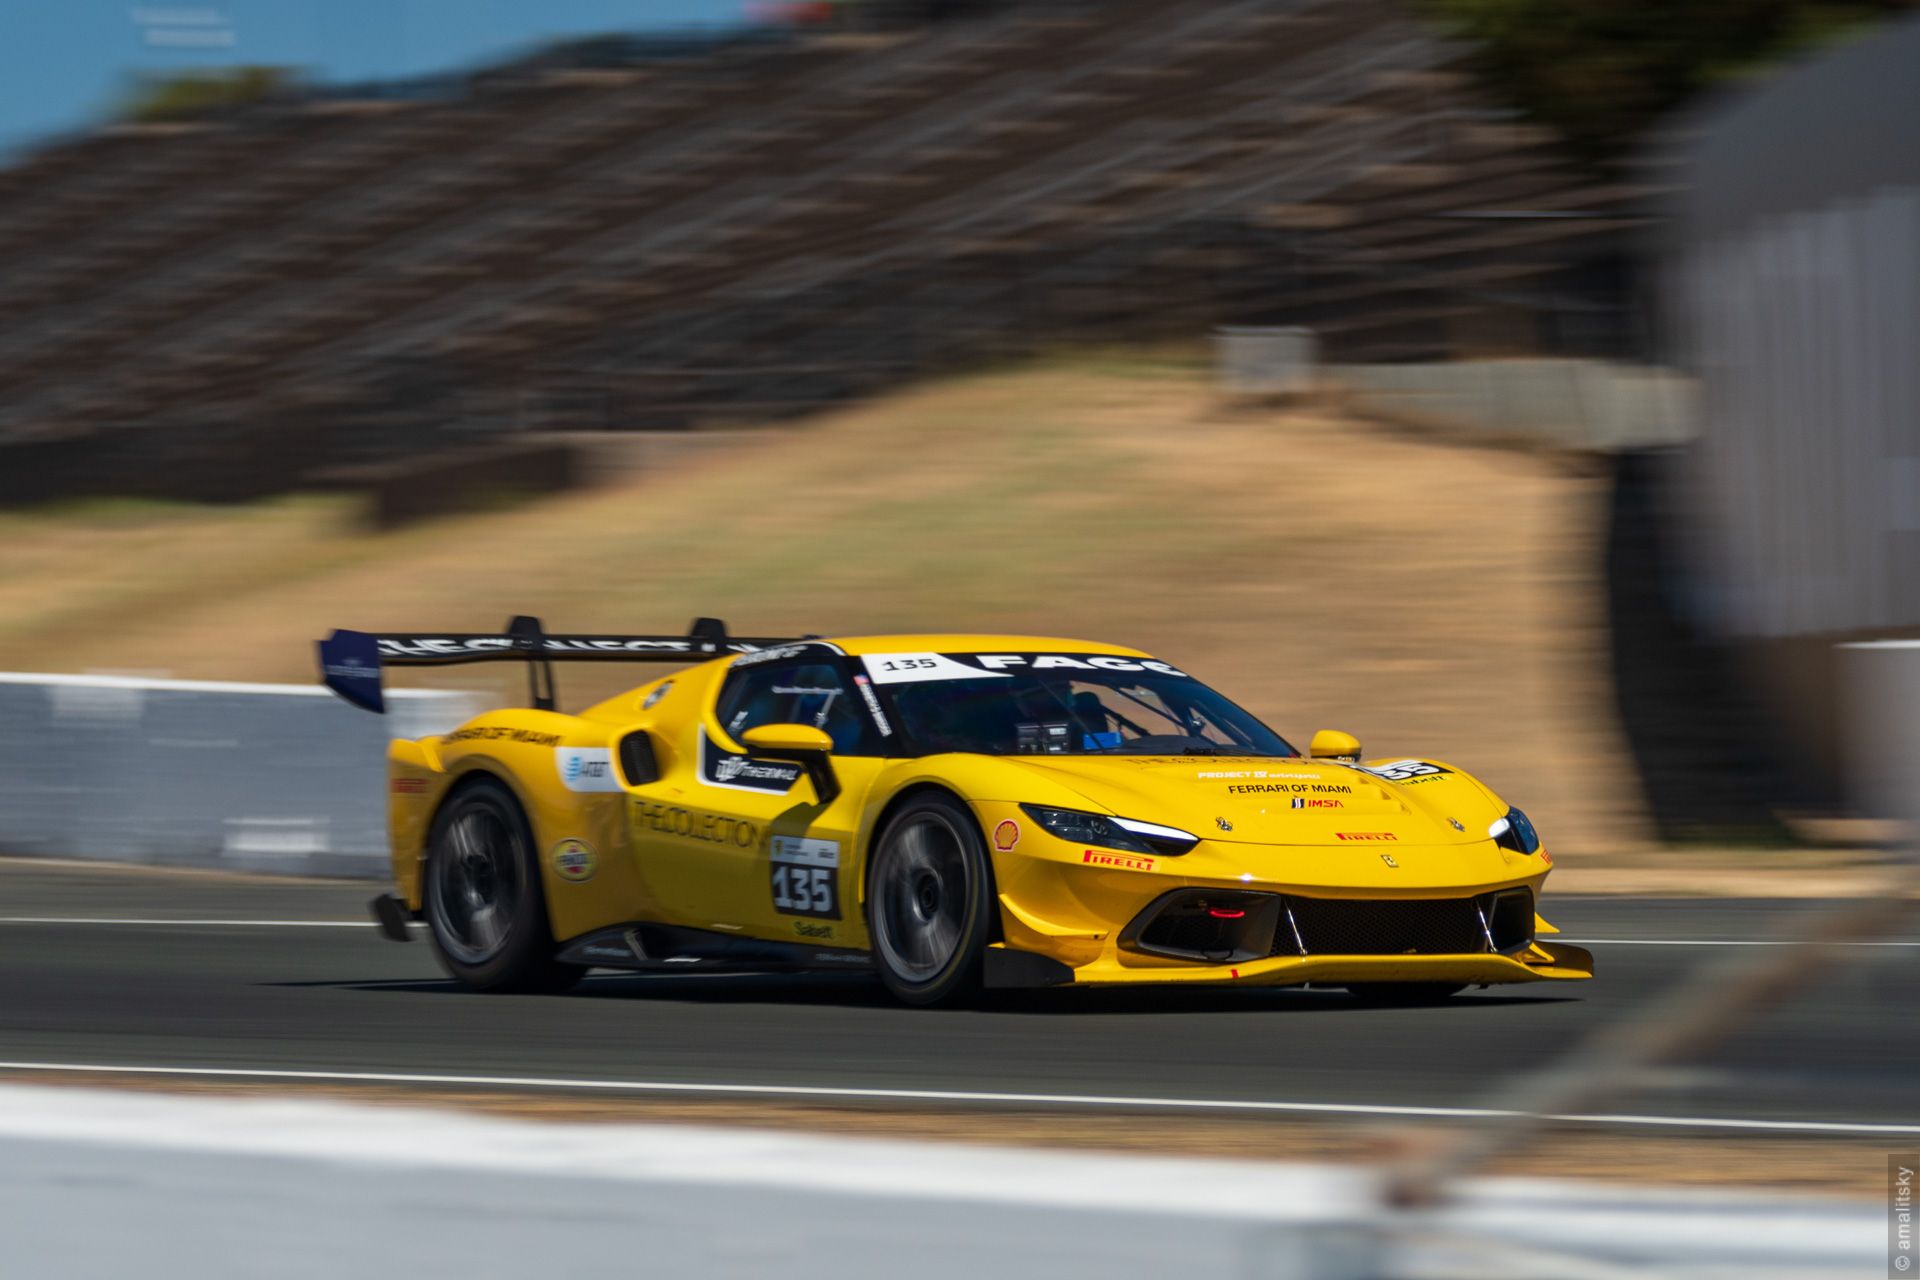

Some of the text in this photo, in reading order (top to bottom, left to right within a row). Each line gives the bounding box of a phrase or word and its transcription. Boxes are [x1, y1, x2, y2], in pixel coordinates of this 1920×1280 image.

[882, 658, 937, 671] 135
[976, 655, 1188, 677] FACE
[1198, 771, 1250, 779] PROJECT
[1228, 784, 1352, 794] FERRARI OF MIAMI
[1308, 799, 1344, 808] IMSA
[1335, 832, 1397, 840] PIRELLI
[1083, 849, 1154, 871] PIRELLI
[772, 865, 833, 912] 135
